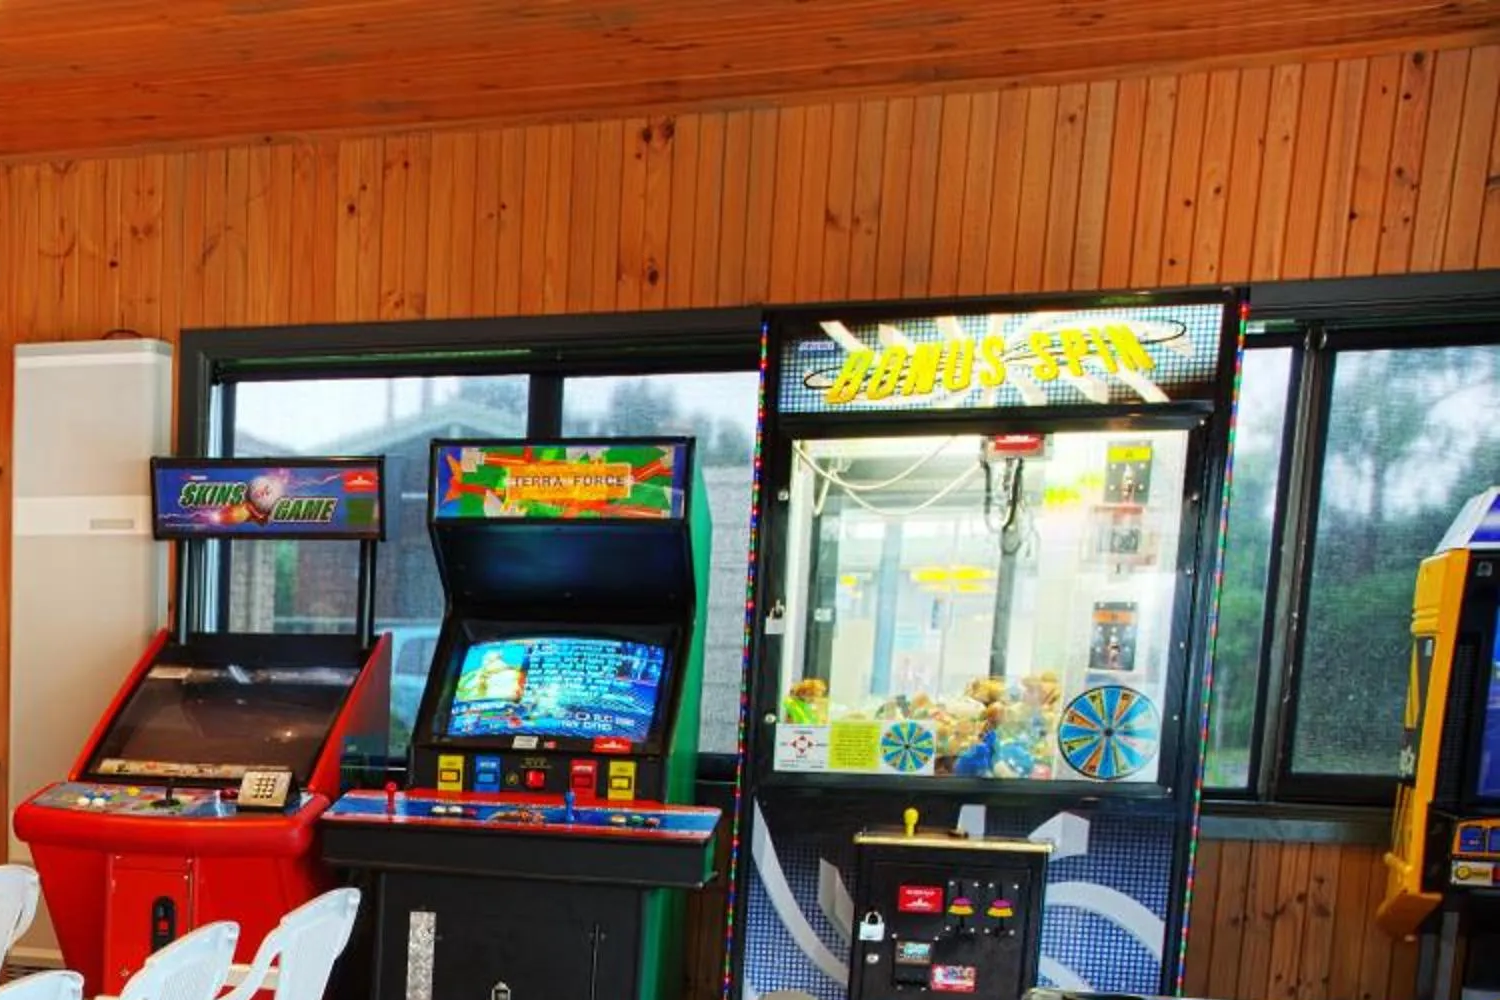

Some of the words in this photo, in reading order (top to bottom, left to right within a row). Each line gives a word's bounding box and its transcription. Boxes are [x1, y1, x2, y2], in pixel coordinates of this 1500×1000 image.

[824, 335, 1006, 404] BONUS
[1029, 323, 1156, 382] SPIN
[514, 474, 564, 487] TERRA
[573, 474, 627, 487] FORCE
[179, 482, 247, 509] SKINS
[271, 498, 338, 523] GAME
